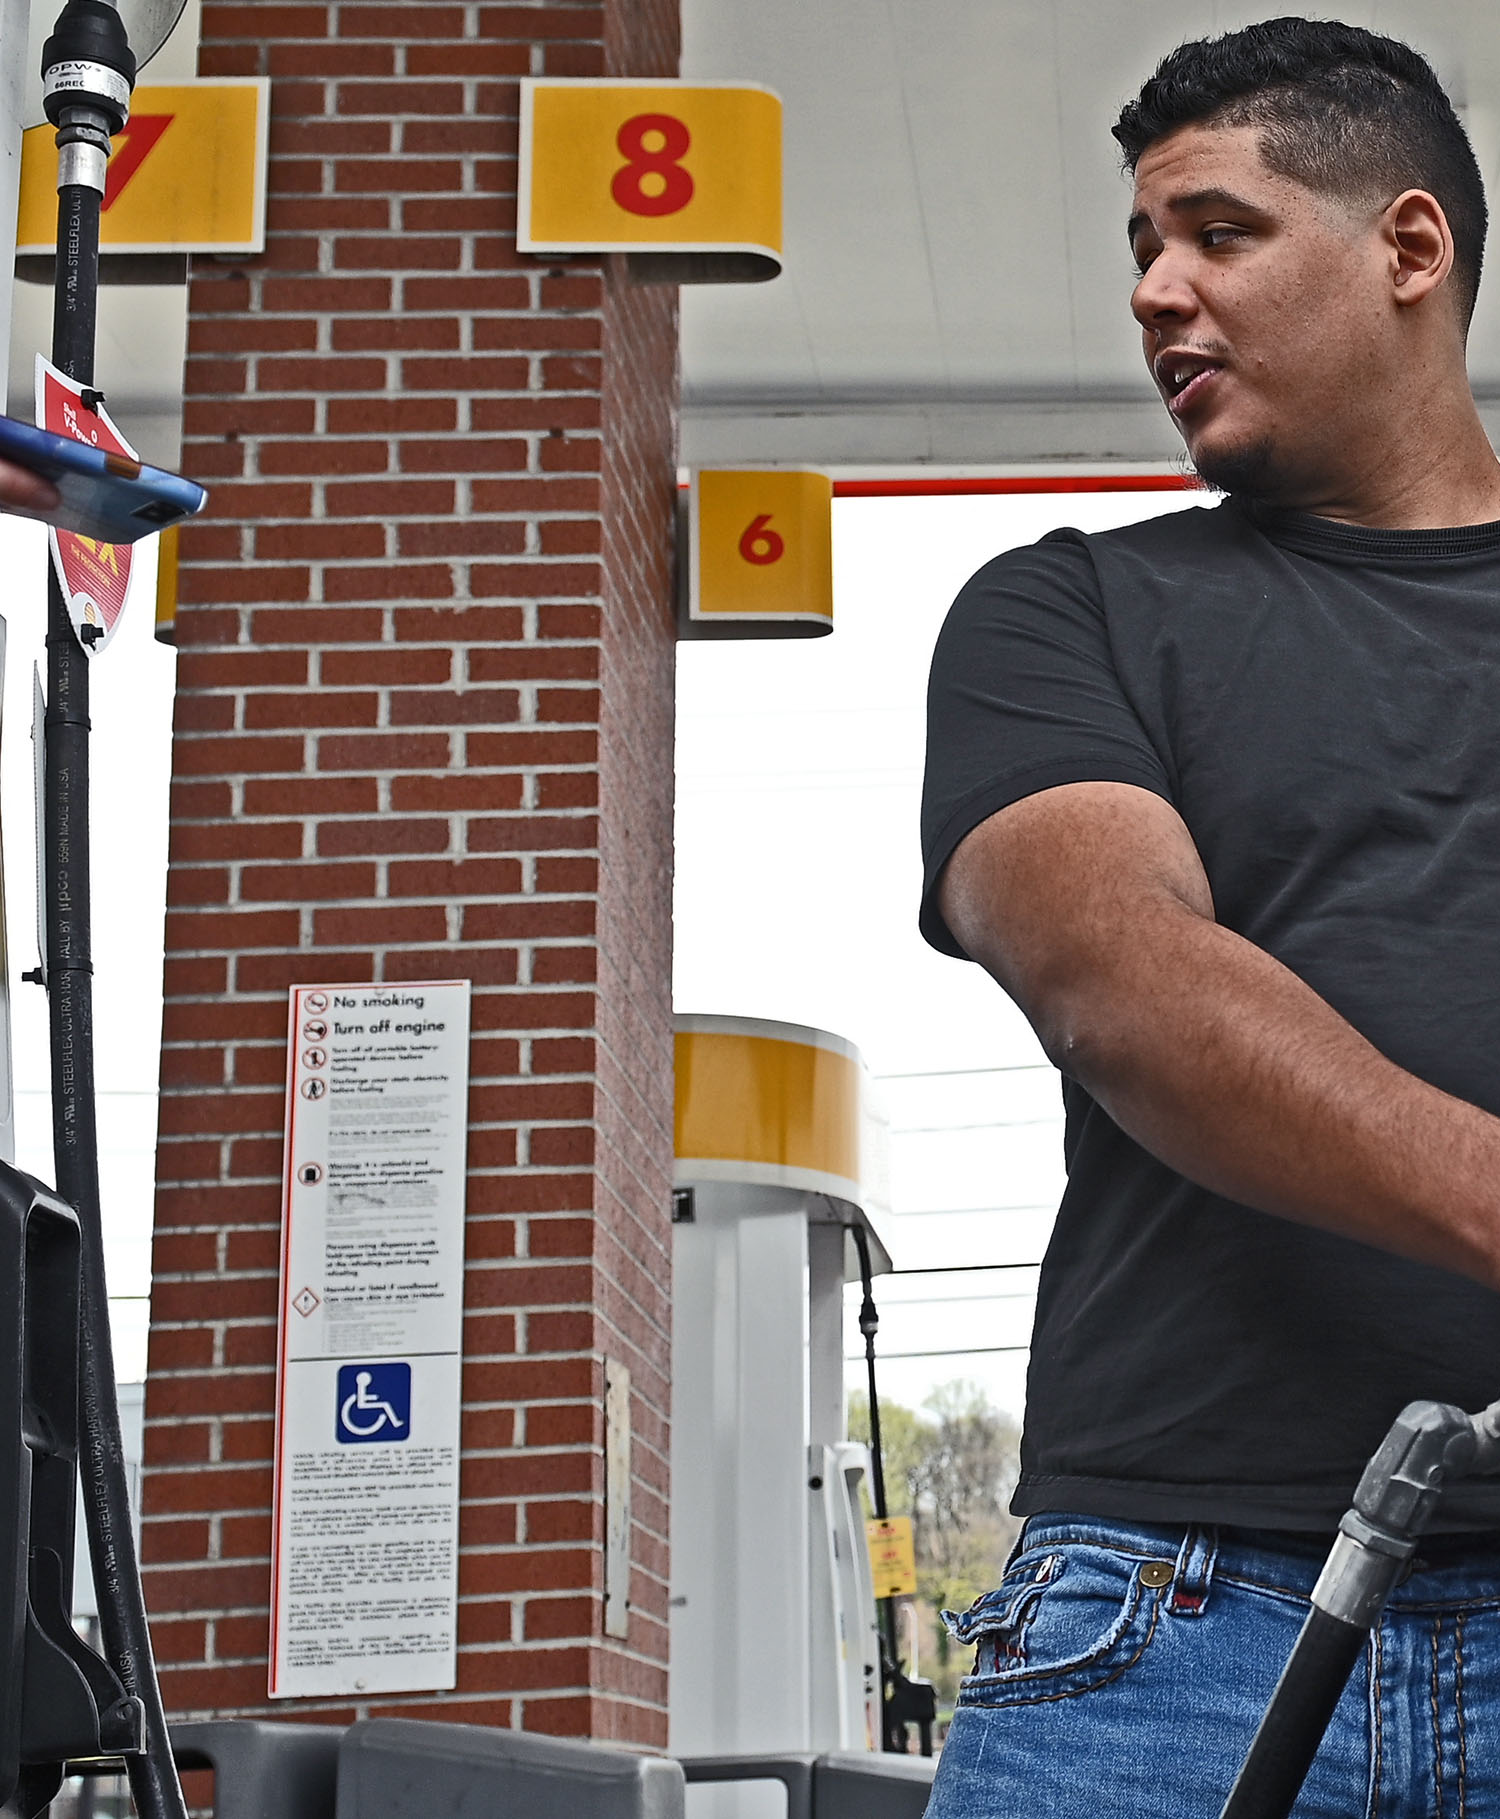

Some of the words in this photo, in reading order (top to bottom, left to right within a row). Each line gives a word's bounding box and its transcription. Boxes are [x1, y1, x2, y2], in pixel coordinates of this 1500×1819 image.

[49, 63, 92, 75] OPW
[101, 115, 176, 212] 7
[610, 112, 695, 217] 8
[67, 214, 81, 266] STEELFLEX
[738, 514, 785, 566] 6
[58, 768, 70, 789] USA
[58, 792, 69, 803] IN
[58, 806, 69, 835] MADE
[59, 920, 70, 933] BY
[61, 997, 73, 1031] ULTRA
[333, 996, 356, 1009] No
[363, 994, 424, 1009] smoking
[333, 1022, 364, 1035] Turn
[369, 1019, 390, 1034] off
[395, 1018, 446, 1036] engine
[62, 1034, 75, 1095] STEELFLEX
[90, 1440, 105, 1477] ULTRA
[95, 1480, 112, 1542] STEELFLEX
[119, 1650, 133, 1674] USA
[125, 1677, 136, 1689] IN
